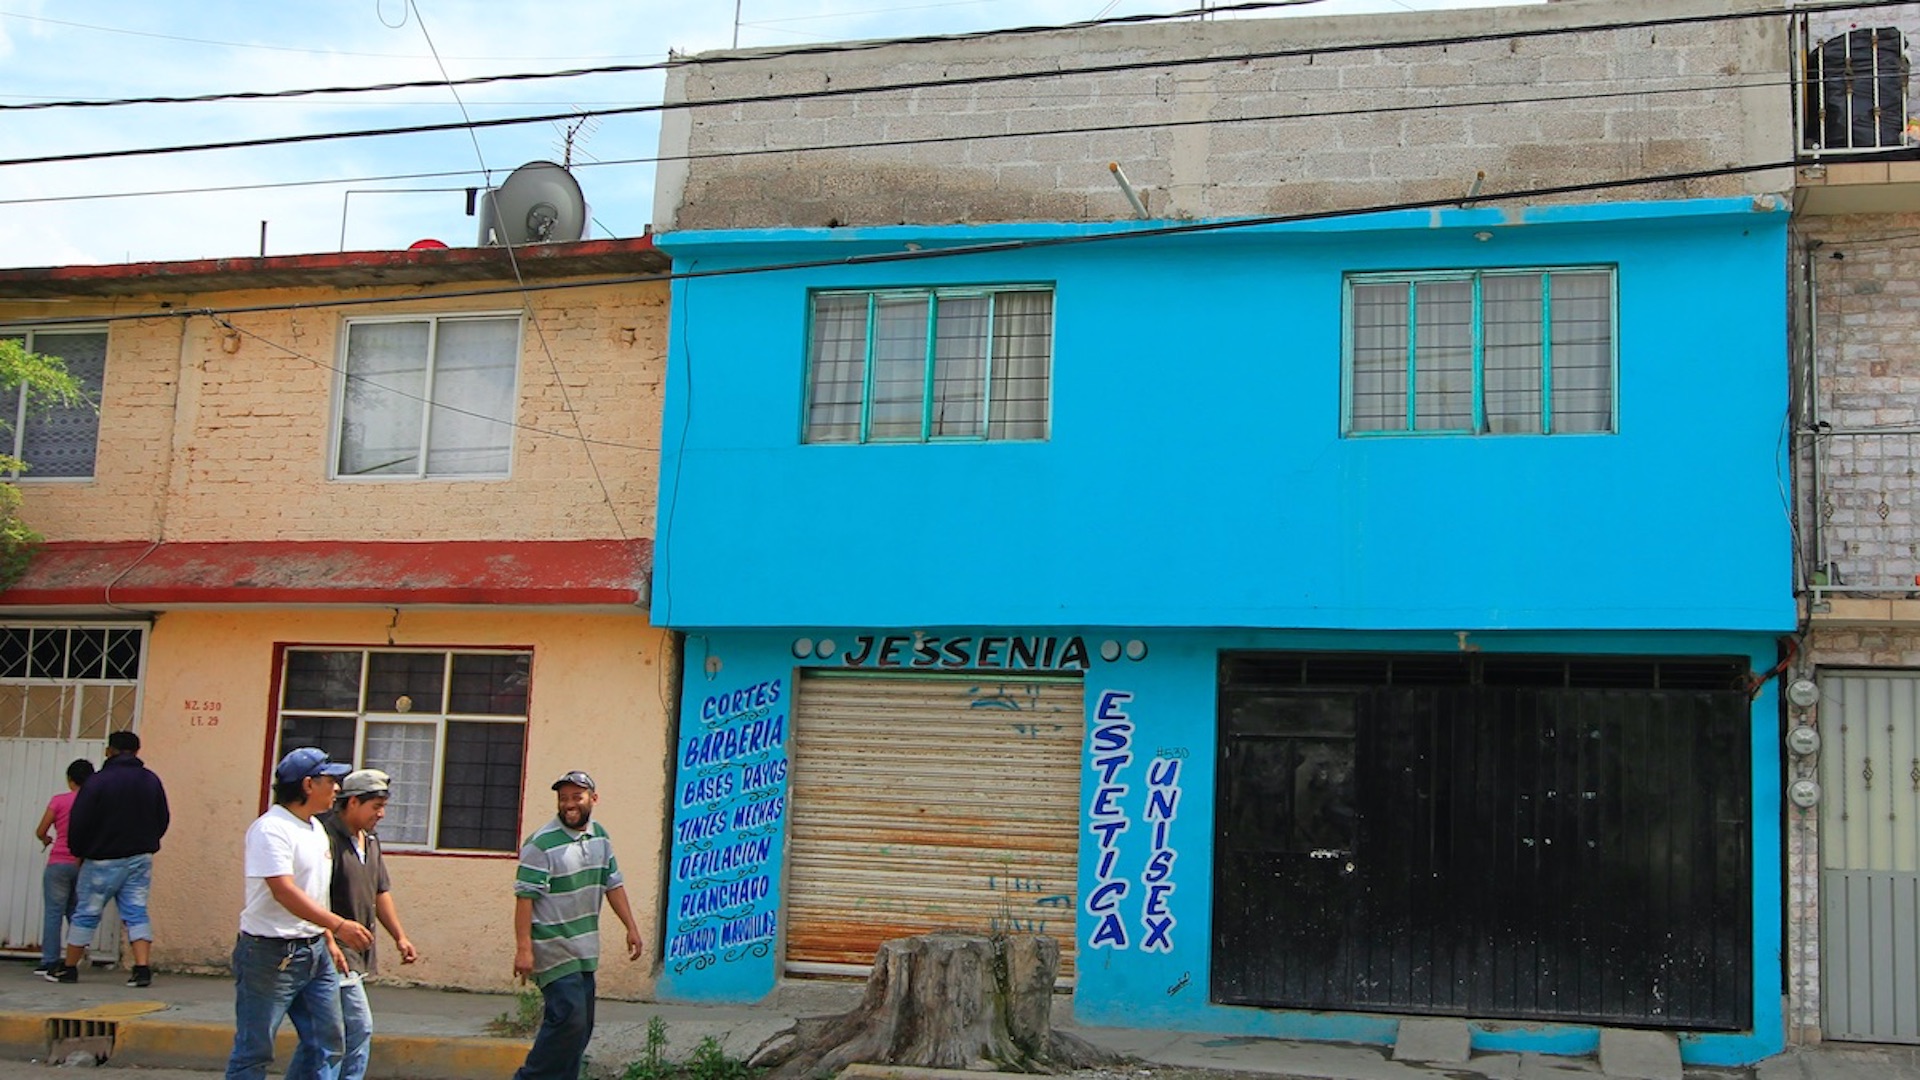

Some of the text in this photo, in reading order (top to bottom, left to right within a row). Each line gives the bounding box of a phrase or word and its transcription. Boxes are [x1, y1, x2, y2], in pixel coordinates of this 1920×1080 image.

[843, 636, 1090, 669] JESSENIA
[203, 701, 222, 711] 530
[700, 679, 781, 723] CORTES
[683, 714, 784, 770] BARBERIA
[1156, 746, 1190, 760] #530
[681, 758, 788, 809] BASES RAYOS
[676, 796, 784, 845] TINTES MECHAS
[1085, 688, 1134, 949] ESTETICA
[676, 836, 771, 882] DEPILACION
[1139, 758, 1180, 953] UNISEX
[678, 875, 769, 921] PLANCHADO
[668, 927, 717, 961] PEINADO
